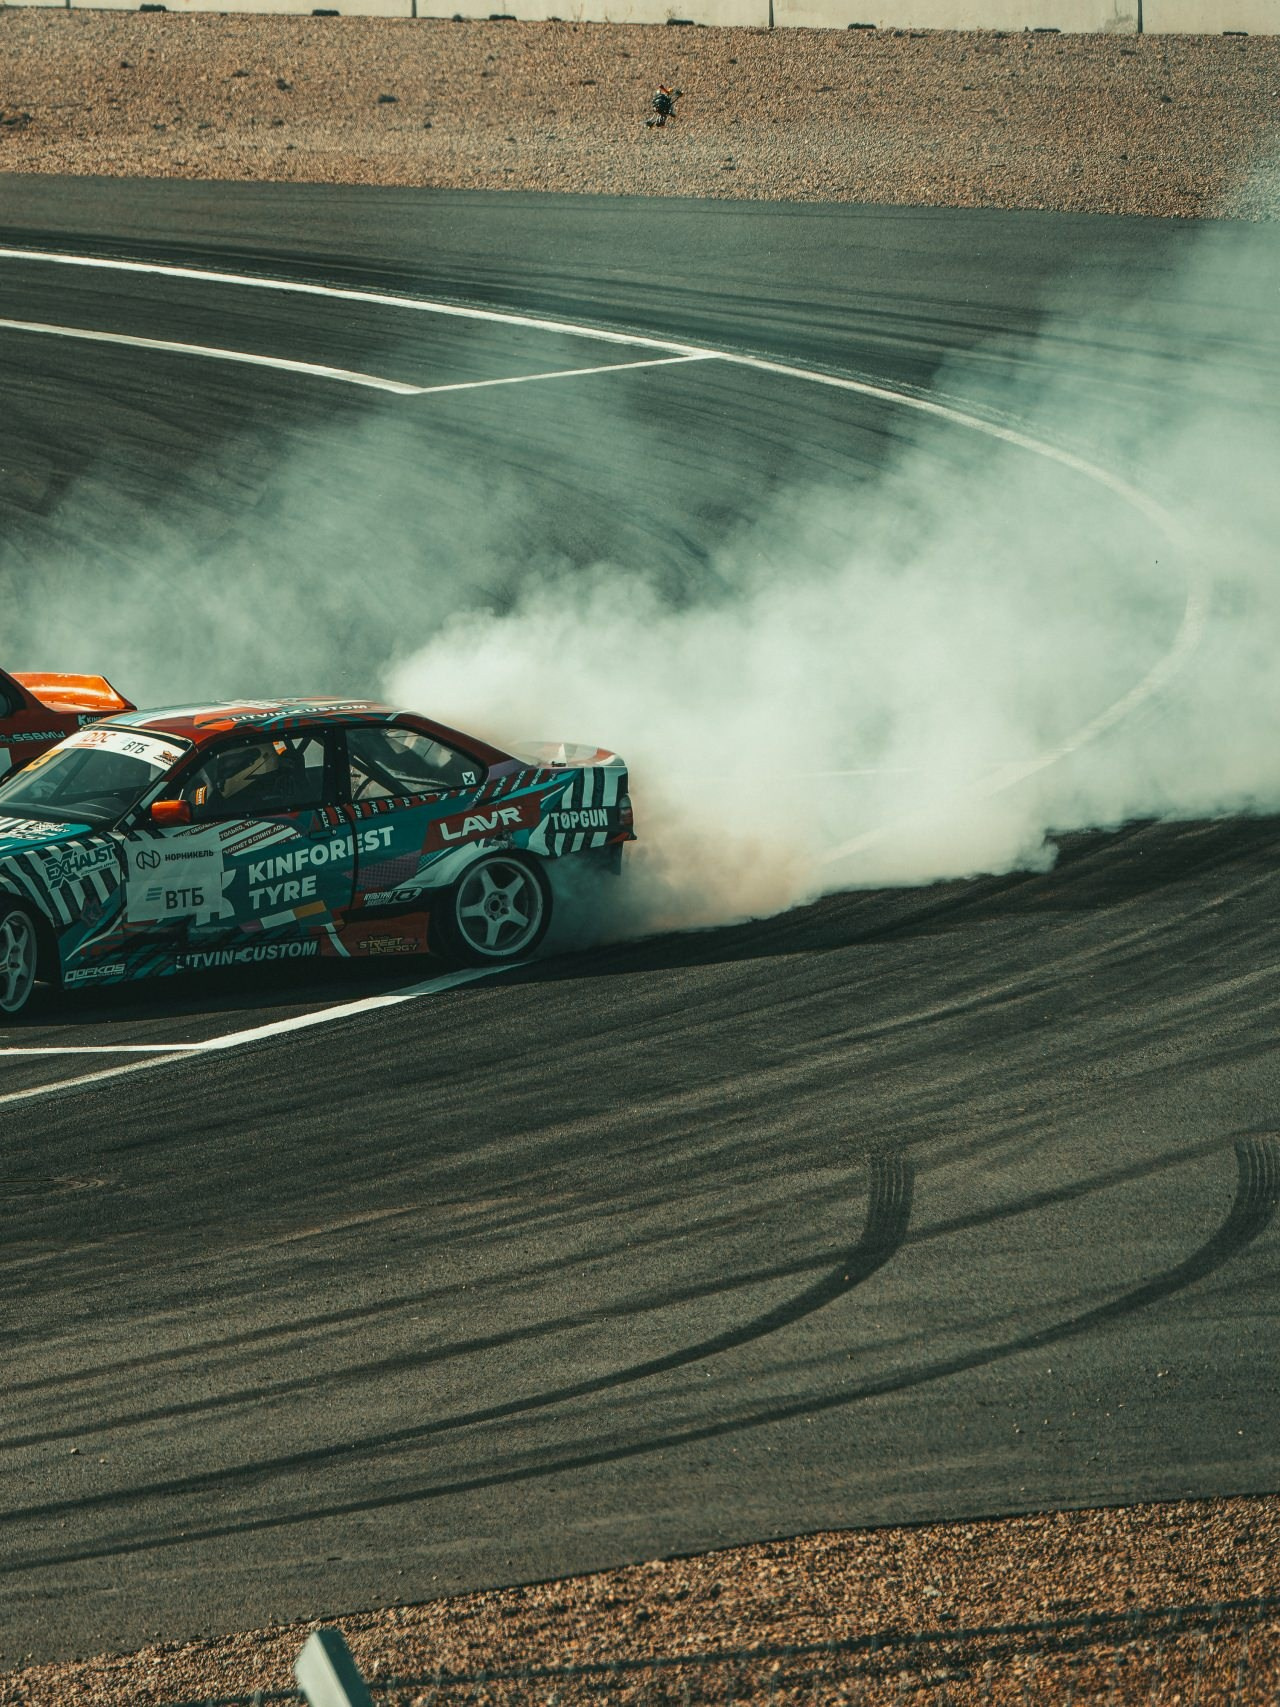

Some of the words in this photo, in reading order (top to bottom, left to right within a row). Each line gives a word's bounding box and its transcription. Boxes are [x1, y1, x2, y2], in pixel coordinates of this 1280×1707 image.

[122, 740, 150, 754] ВТБ
[440, 806, 523, 841] LAVR
[164, 849, 214, 862] НОРНИКЕЛЬ
[248, 825, 394, 885] KINFOREST
[165, 886, 204, 910] ВТБ
[248, 874, 317, 910] TYRE
